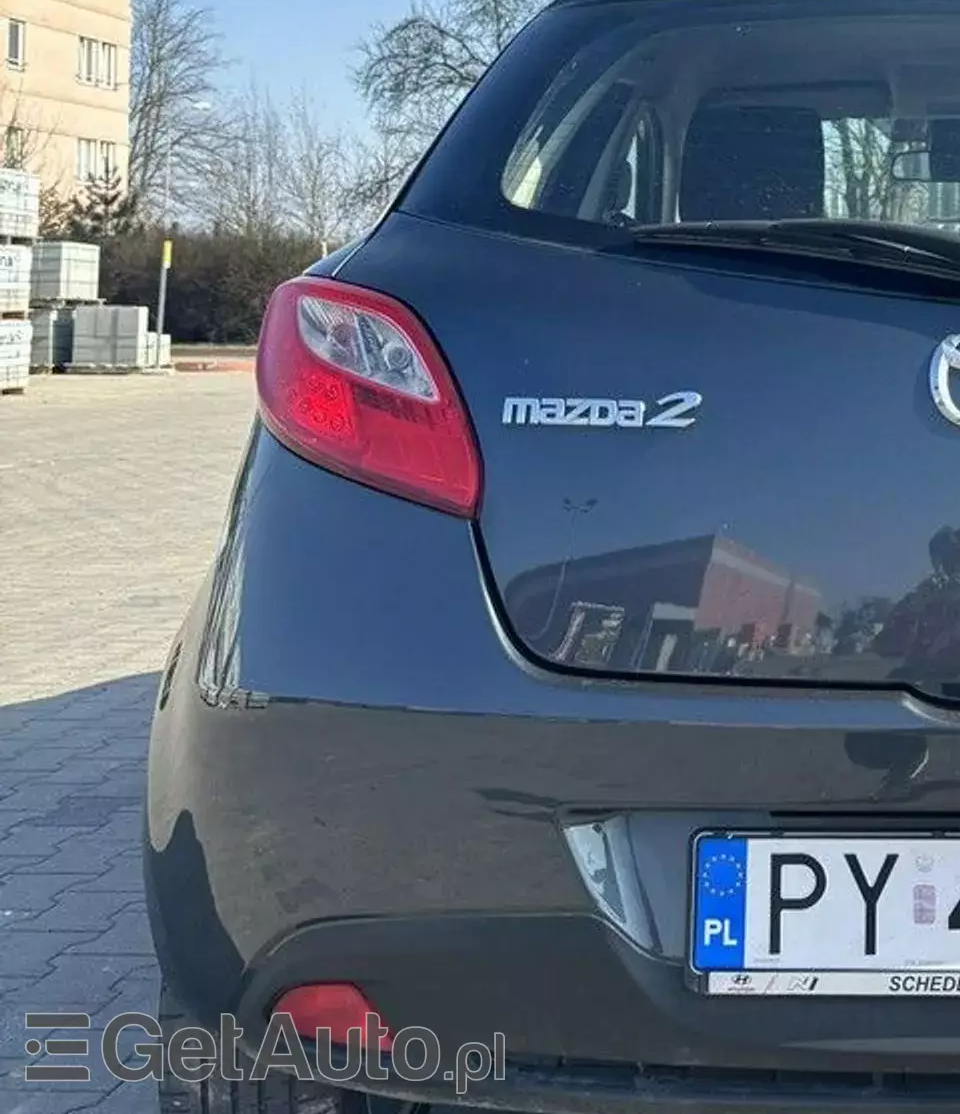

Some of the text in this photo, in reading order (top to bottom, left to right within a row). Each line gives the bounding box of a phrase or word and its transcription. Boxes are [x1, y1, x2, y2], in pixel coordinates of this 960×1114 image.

[645, 391, 702, 428] 2
[768, 852, 899, 956] PY
[703, 918, 738, 947] PL
